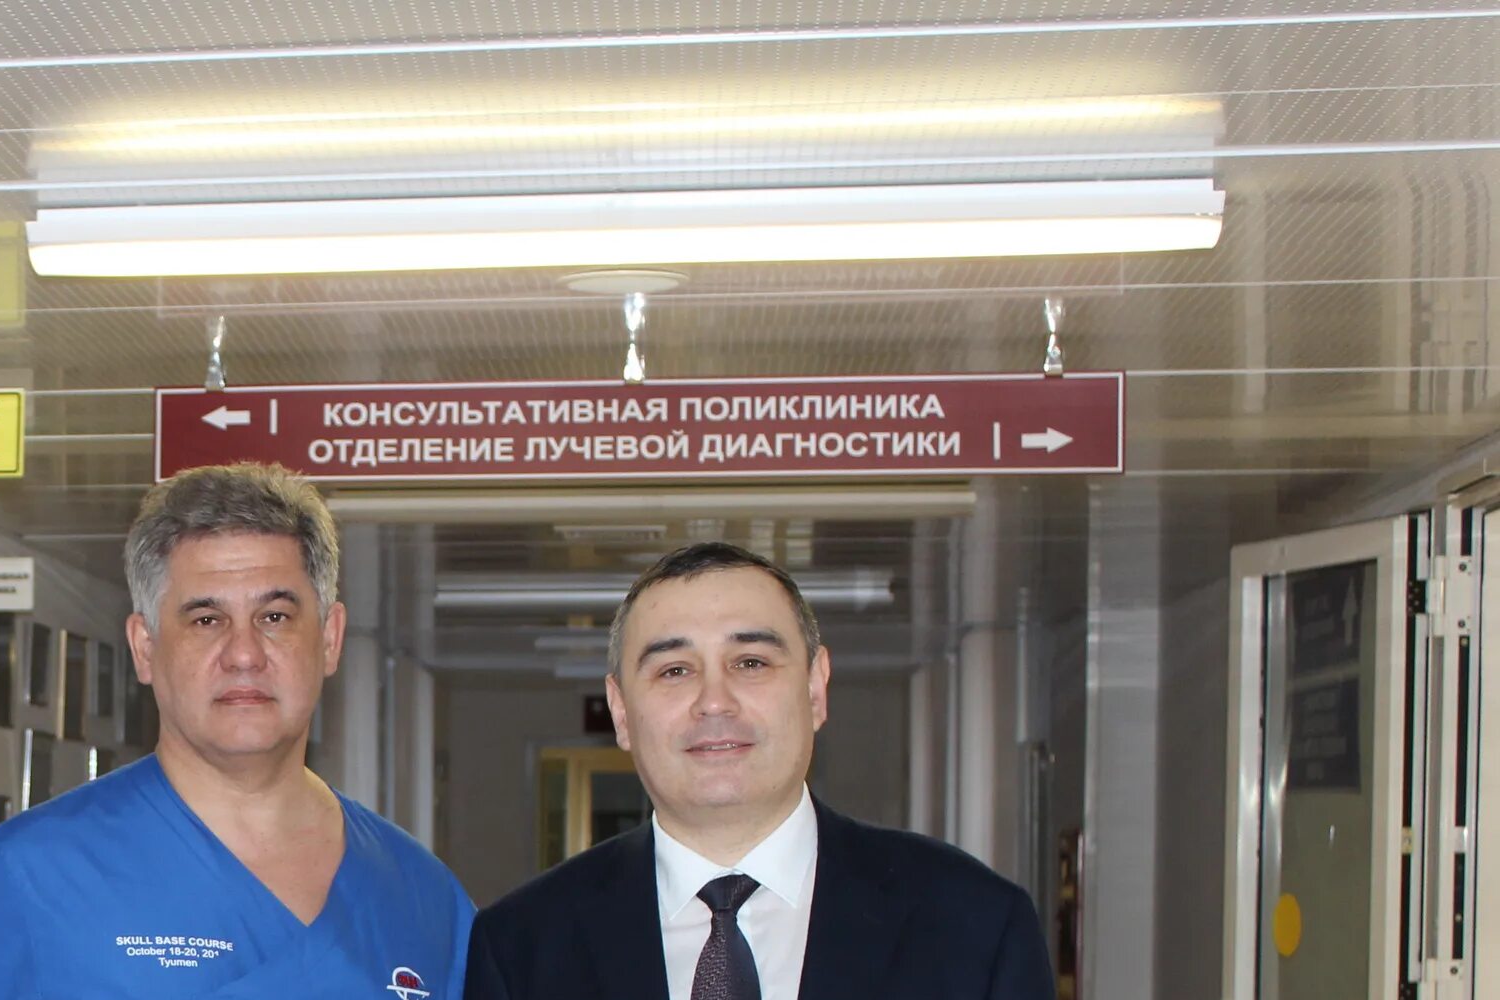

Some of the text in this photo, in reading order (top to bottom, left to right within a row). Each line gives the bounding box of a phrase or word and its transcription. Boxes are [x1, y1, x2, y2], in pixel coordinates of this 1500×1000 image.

[323, 394, 945, 426] КОНСУЛЬТАТИВНАЯ ПОЛИКЛИНИКА
[308, 429, 961, 467] ОТДЕЛЕНИЕ ЛУЧЕВОЙ ДИАГНОСТИКИ
[115, 935, 234, 951] SKULL BASE COURSE
[126, 946, 166, 957] October
[169, 947, 200, 958] 18-20,
[158, 957, 198, 968] Tyumen
